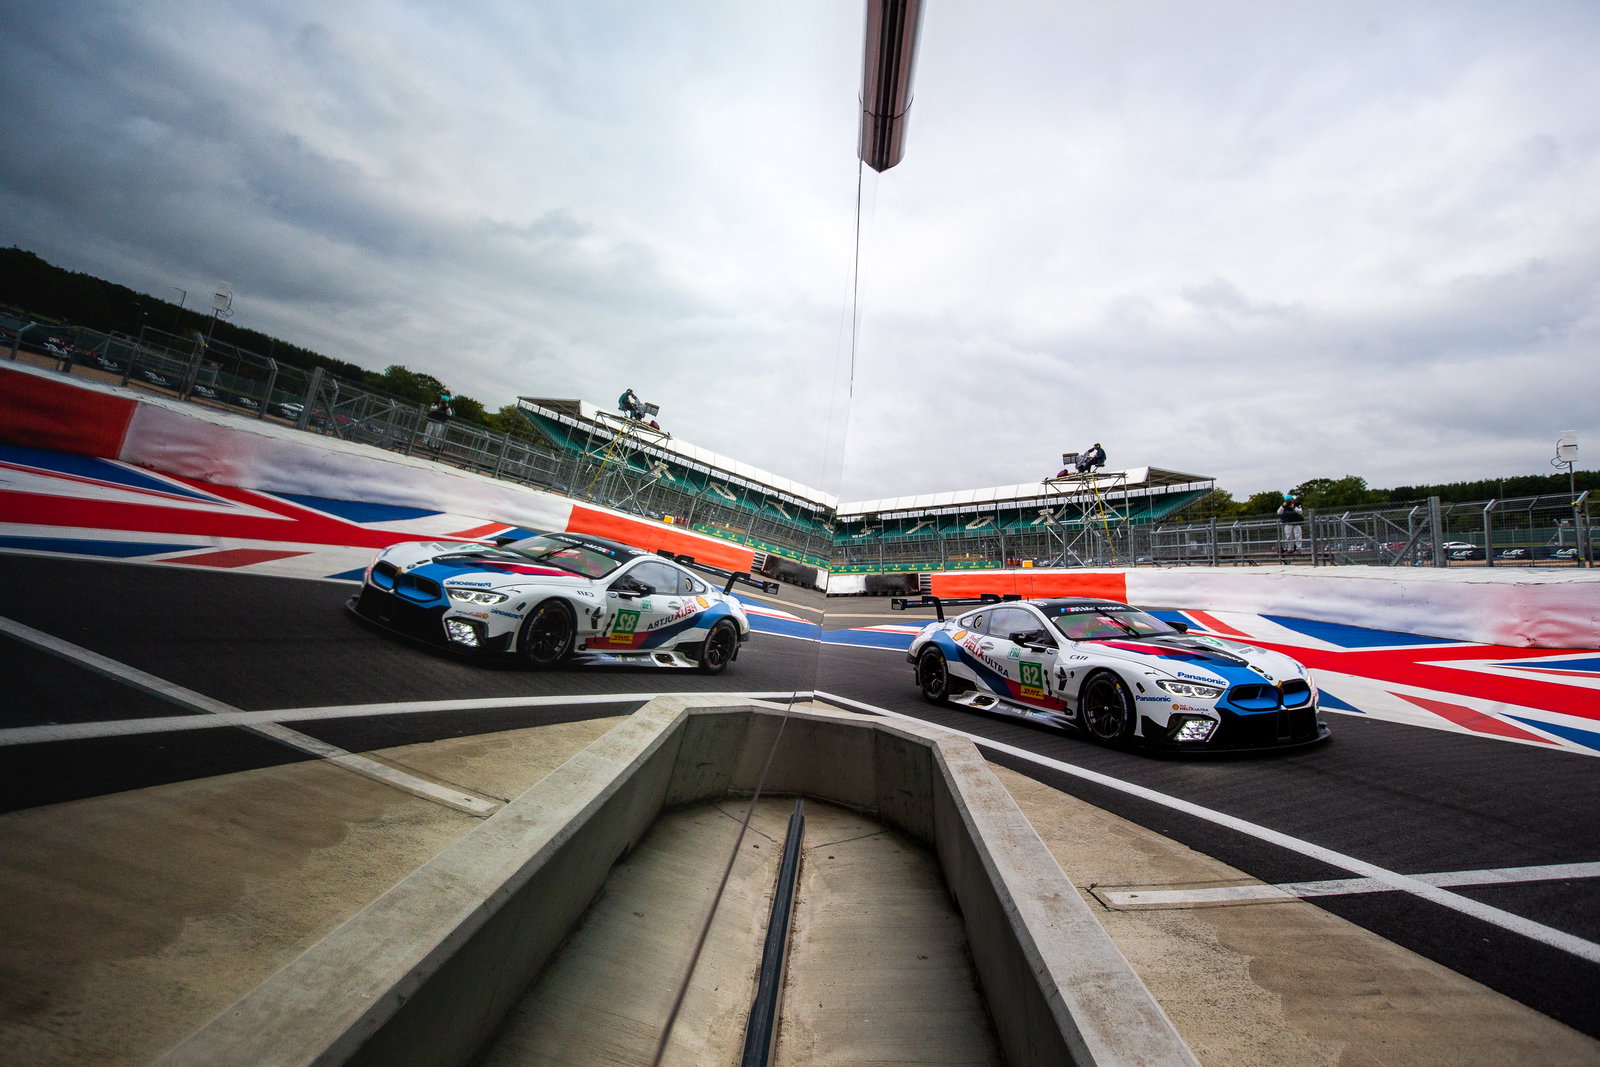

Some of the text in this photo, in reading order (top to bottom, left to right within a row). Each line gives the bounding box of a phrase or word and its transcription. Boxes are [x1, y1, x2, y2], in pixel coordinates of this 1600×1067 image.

[963, 639, 1009, 678] HELIX ULTRA
[1022, 665, 1040, 685] 82
[1177, 671, 1227, 686] Panasonic
[1023, 688, 1041, 696] DHL
